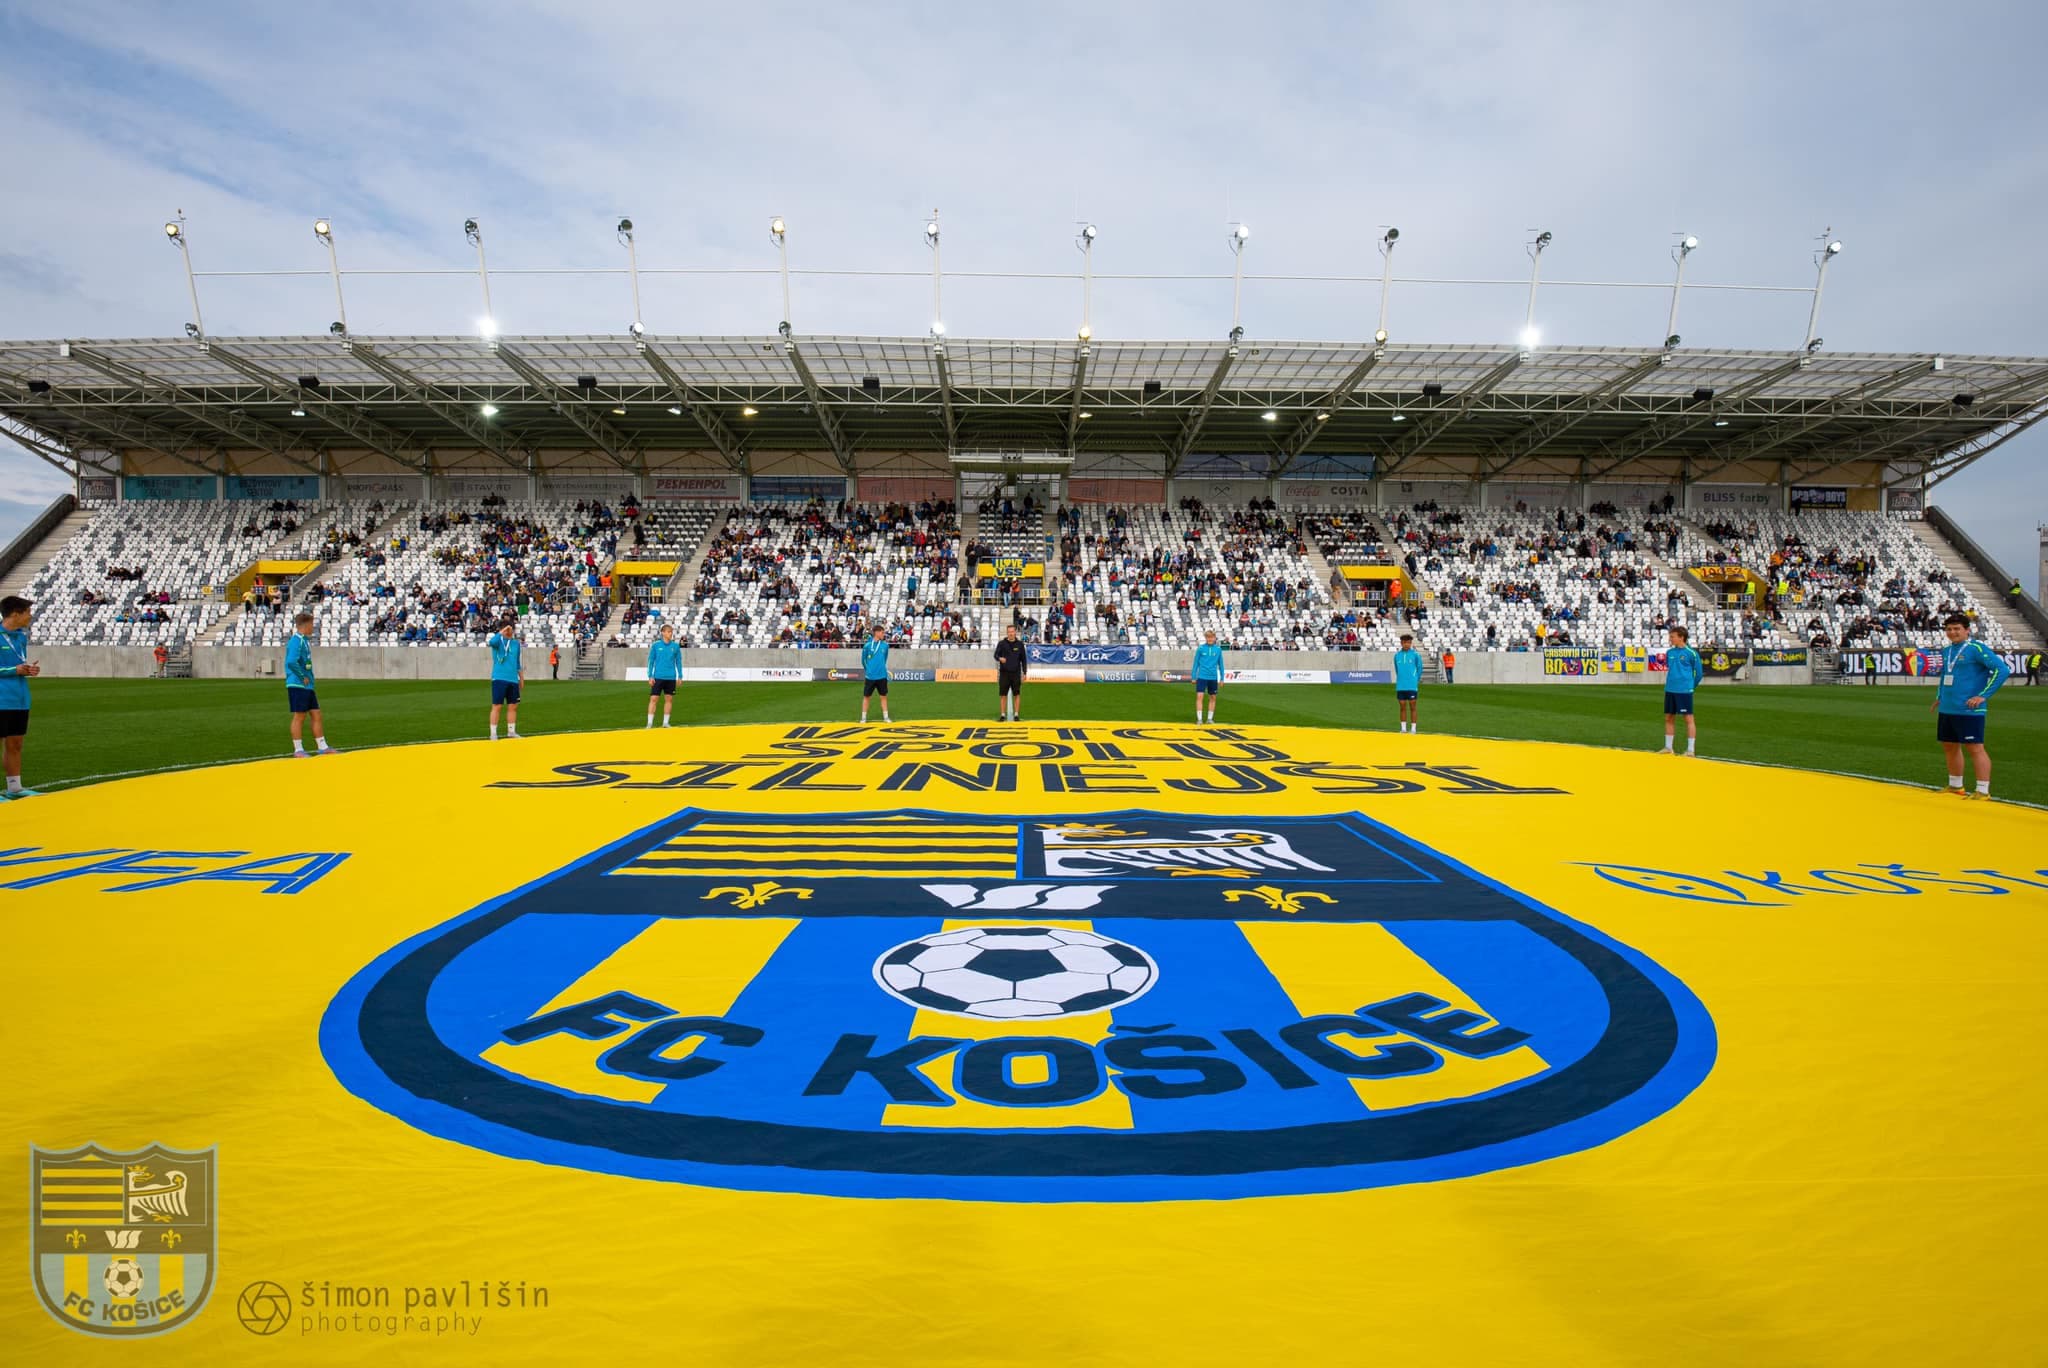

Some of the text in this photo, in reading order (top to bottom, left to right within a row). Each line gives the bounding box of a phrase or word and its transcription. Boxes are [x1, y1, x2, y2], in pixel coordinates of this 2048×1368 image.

[1331, 486, 1368, 496] COSTA
[1703, 492, 1769, 505] BLISS farby
[996, 567, 1023, 576] VSS
[1081, 653, 1109, 661] LIGA
[1544, 648, 1598, 657] CASSOVIA CITY
[893, 671, 925, 681] KOŠICE
[1104, 671, 1136, 681] KOŠICE
[741, 741, 1292, 761] SPOLU
[500, 991, 1533, 1106] FC KOŠICE
